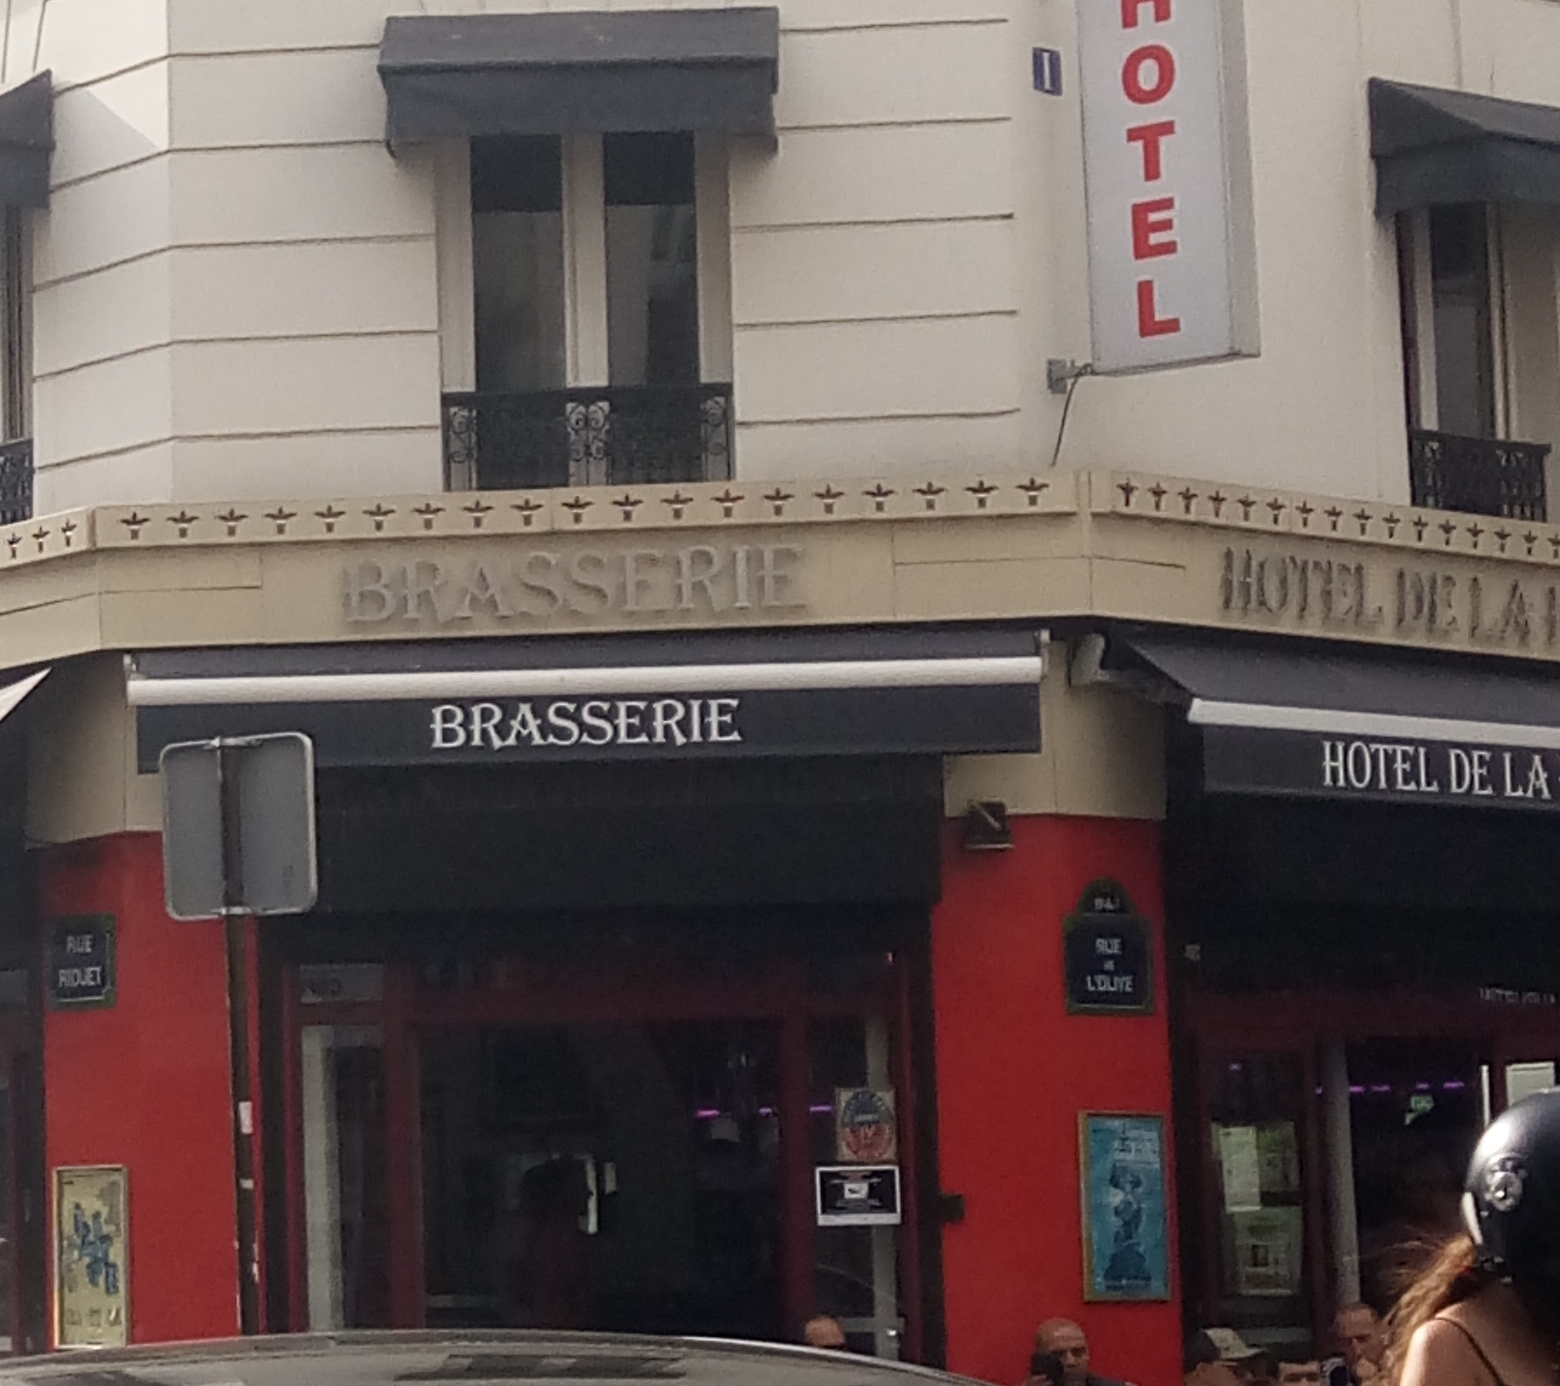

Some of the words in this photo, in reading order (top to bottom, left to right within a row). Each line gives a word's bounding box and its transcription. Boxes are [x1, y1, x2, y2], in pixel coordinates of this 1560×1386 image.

[343, 543, 807, 624] BRASSERIE
[1221, 546, 1384, 626] HOTEL
[1395, 566, 1460, 636] DE
[1467, 575, 1533, 647] LA
[430, 697, 742, 750] BRASSERIE
[1322, 740, 1439, 793] HOTEL
[1448, 748, 1494, 795] DE
[1502, 752, 1552, 800] LA
[67, 934, 93, 954] RUE
[1095, 937, 1122, 954] RUE
